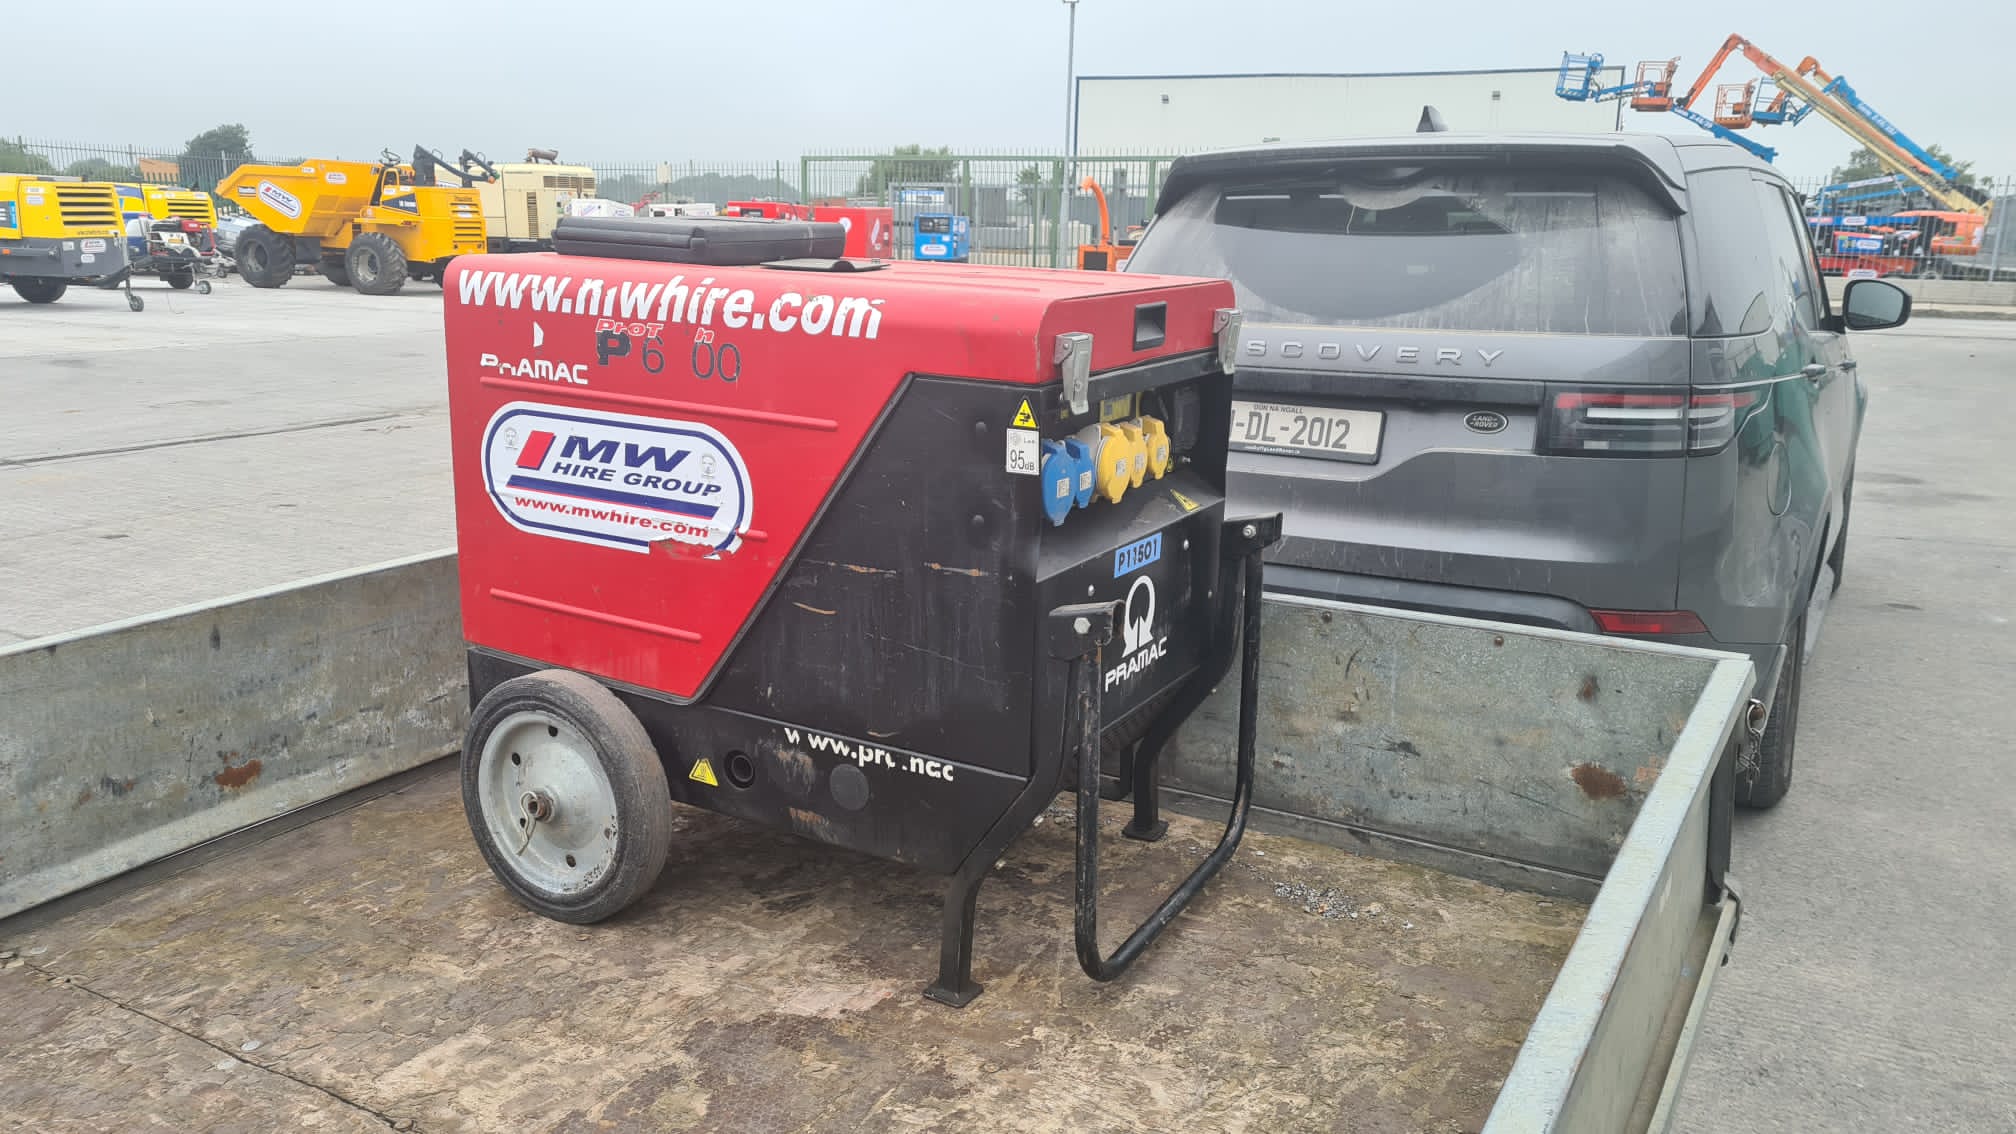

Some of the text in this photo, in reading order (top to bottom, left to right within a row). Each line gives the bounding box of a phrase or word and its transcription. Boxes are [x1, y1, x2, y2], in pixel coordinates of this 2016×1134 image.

[560, 435, 692, 473] MW
[552, 461, 722, 497] HIRE GROUP
[514, 496, 709, 538] www.mwhire.com
[1117, 537, 1158, 573] P11501
[1104, 636, 1168, 693] PRAMAC
